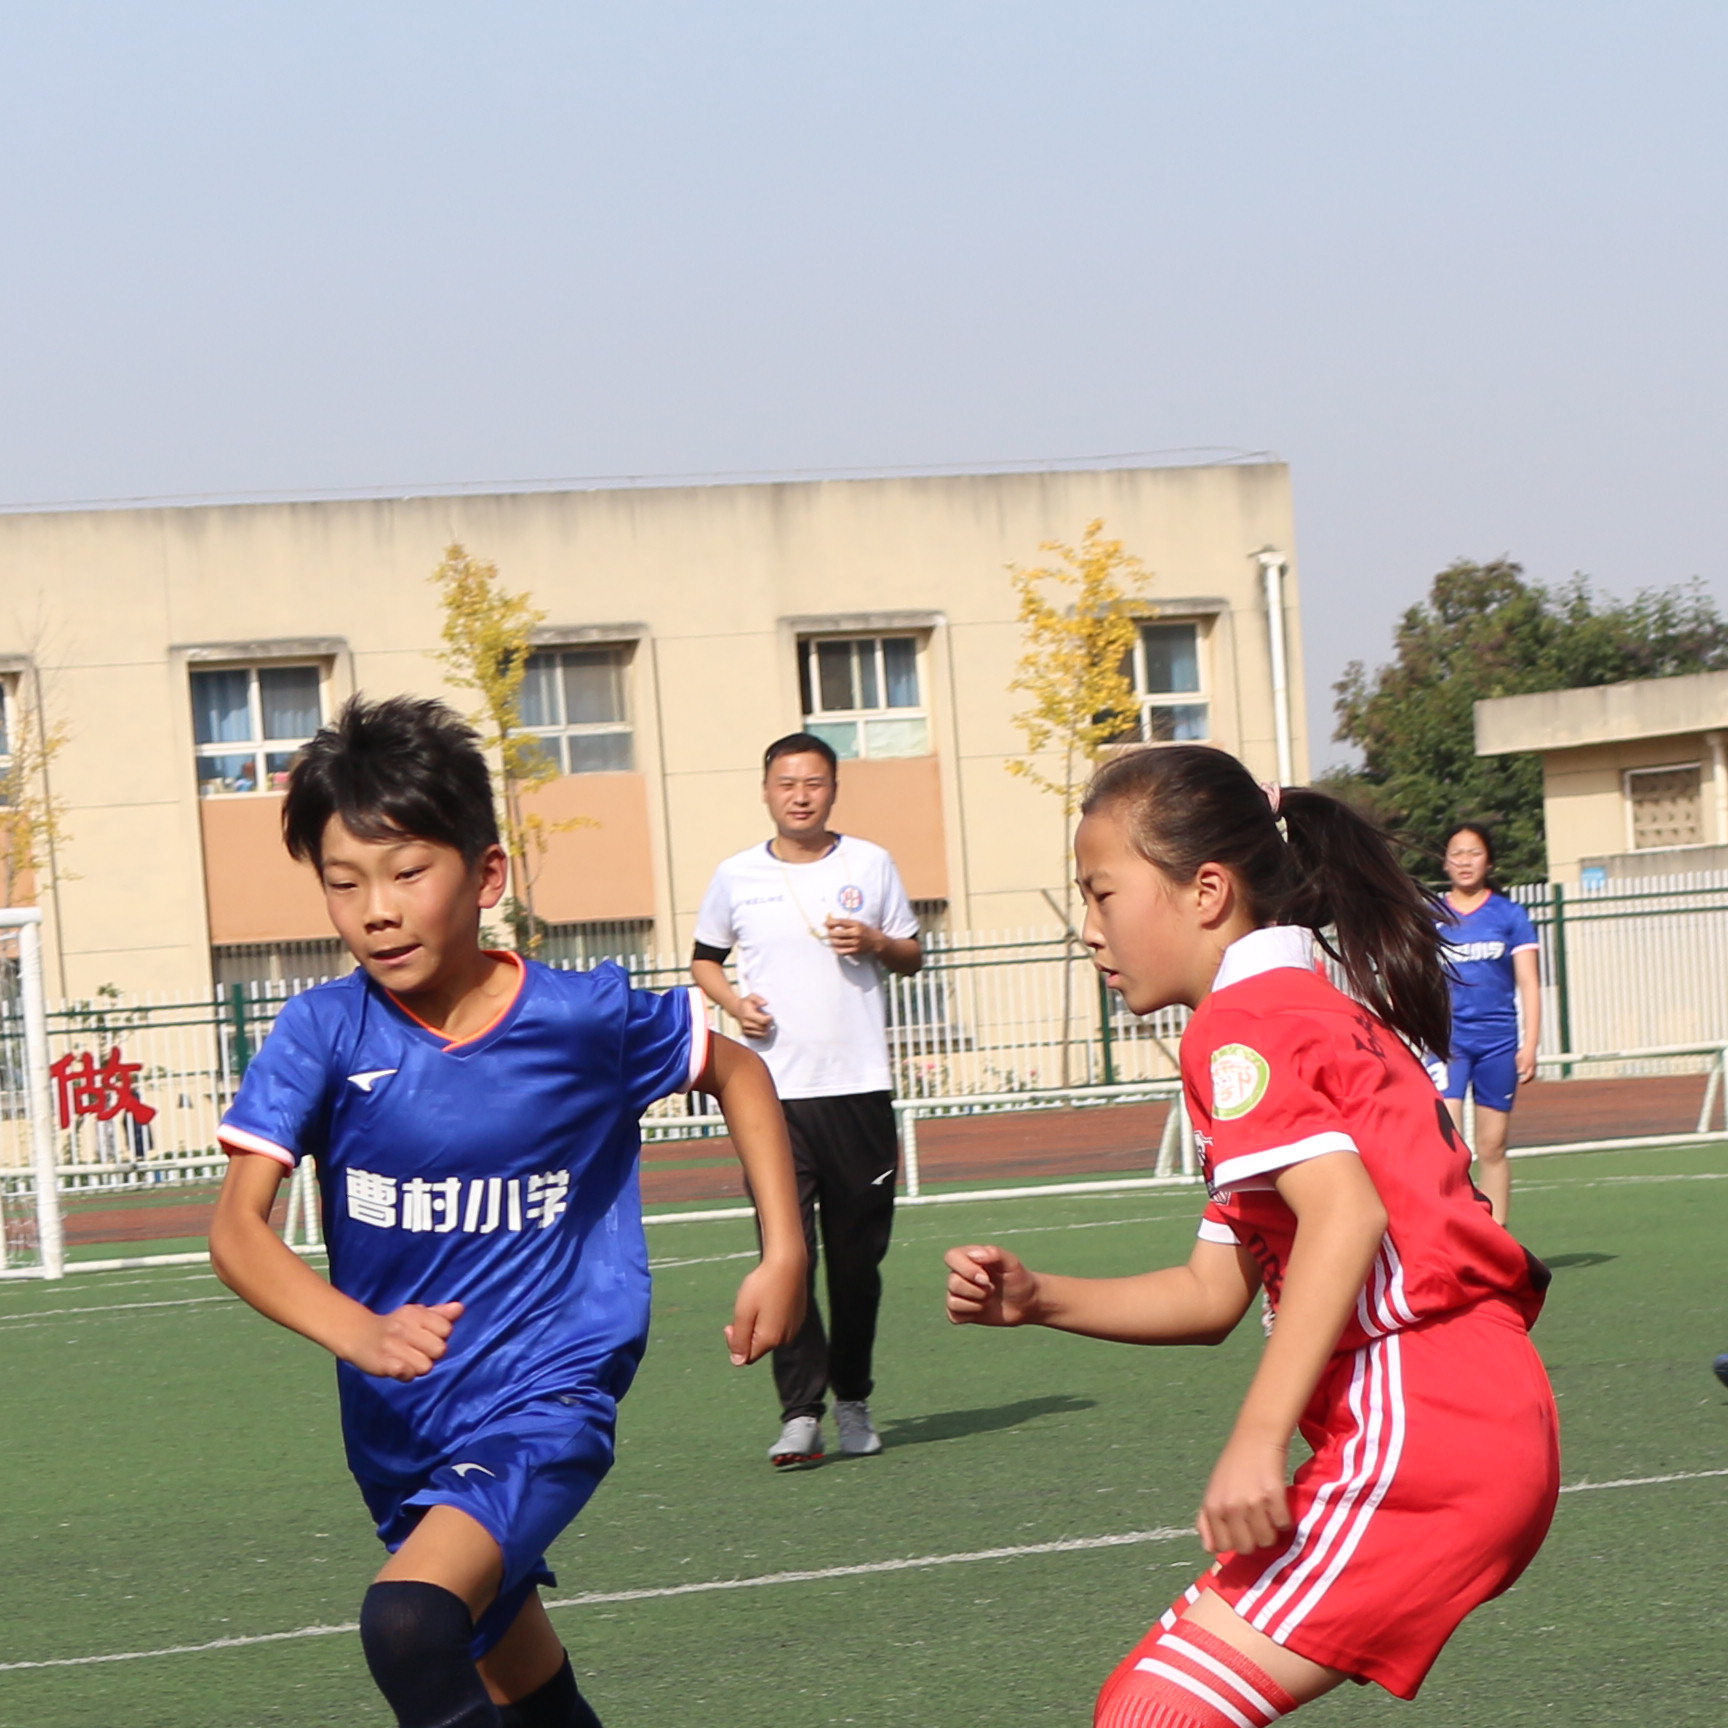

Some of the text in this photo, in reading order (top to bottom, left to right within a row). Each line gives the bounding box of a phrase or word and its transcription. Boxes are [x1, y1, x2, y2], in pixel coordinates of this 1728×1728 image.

[49, 1045, 158, 1130] 做
[345, 1166, 571, 1234] 曹村小学
